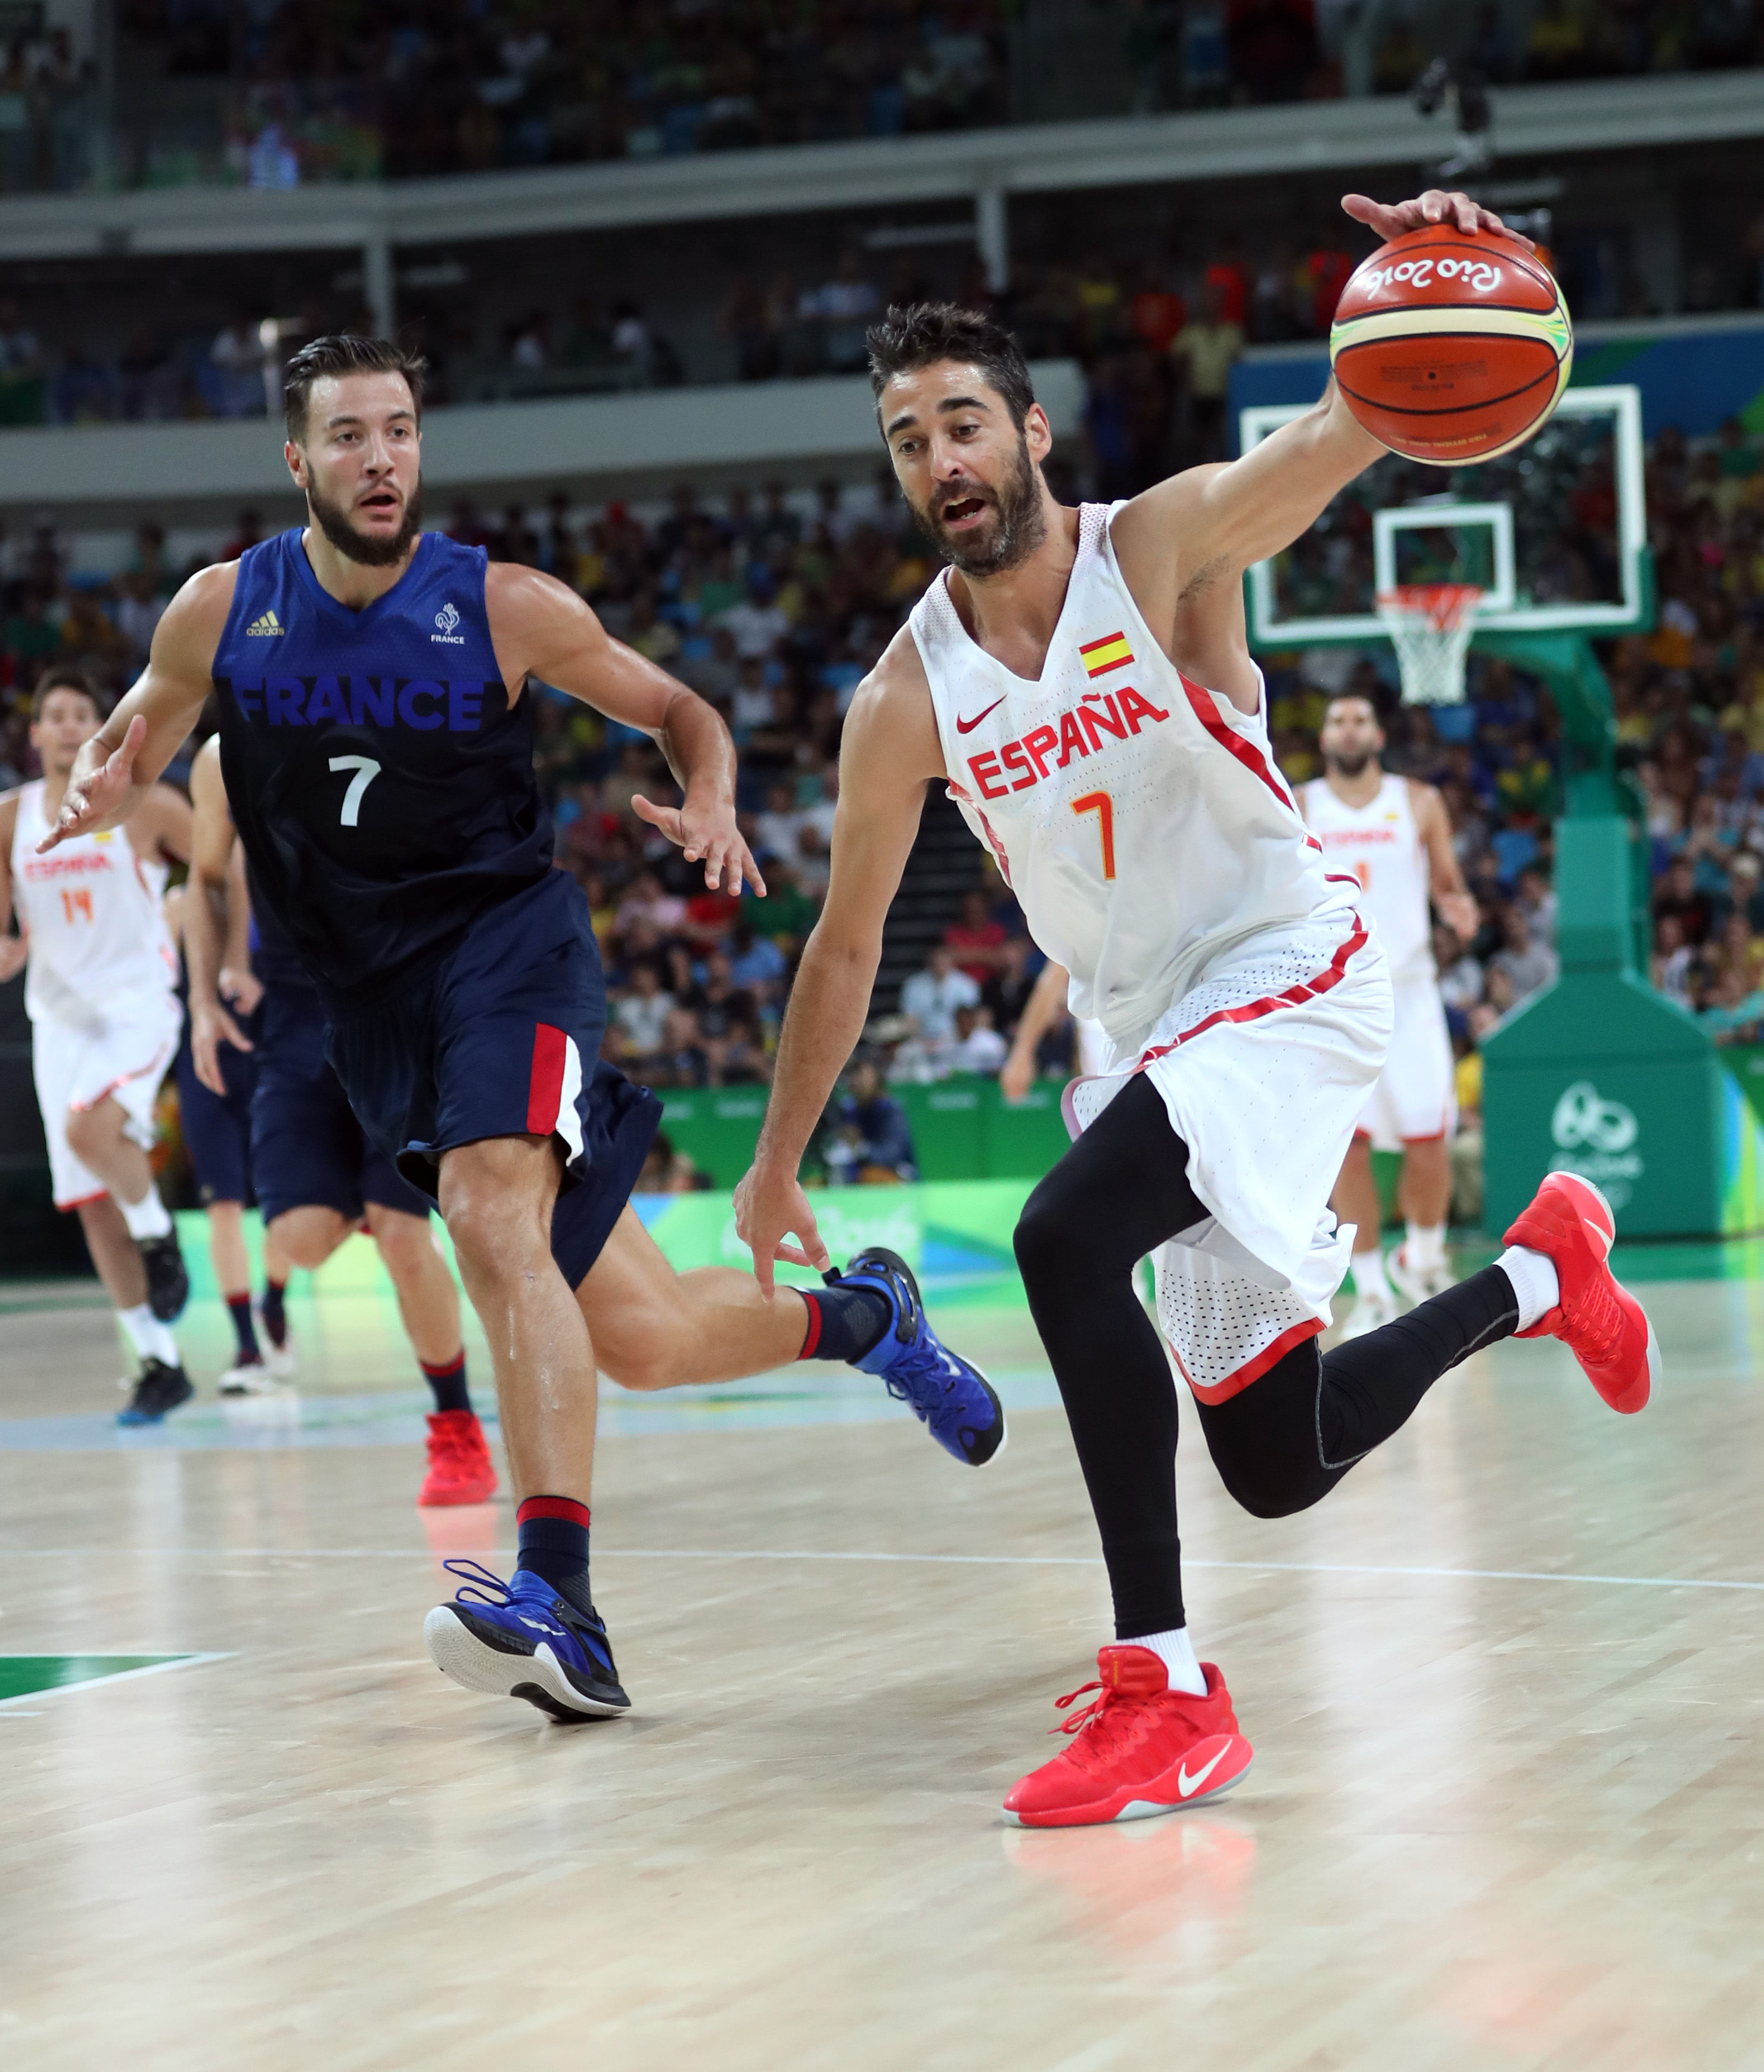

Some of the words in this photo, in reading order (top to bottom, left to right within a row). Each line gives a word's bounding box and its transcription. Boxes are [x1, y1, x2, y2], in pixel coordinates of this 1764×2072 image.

[1365, 259, 1434, 300] 2016
[1436, 258, 1501, 291] Rio
[246, 626, 284, 637] adidas
[431, 634, 464, 645] FRANCE
[230, 675, 485, 731] FRANCE
[967, 686, 1170, 800] ESPAÑA
[328, 755, 381, 827] 7
[1070, 790, 1116, 880] 7
[61, 889, 93, 924] 14
